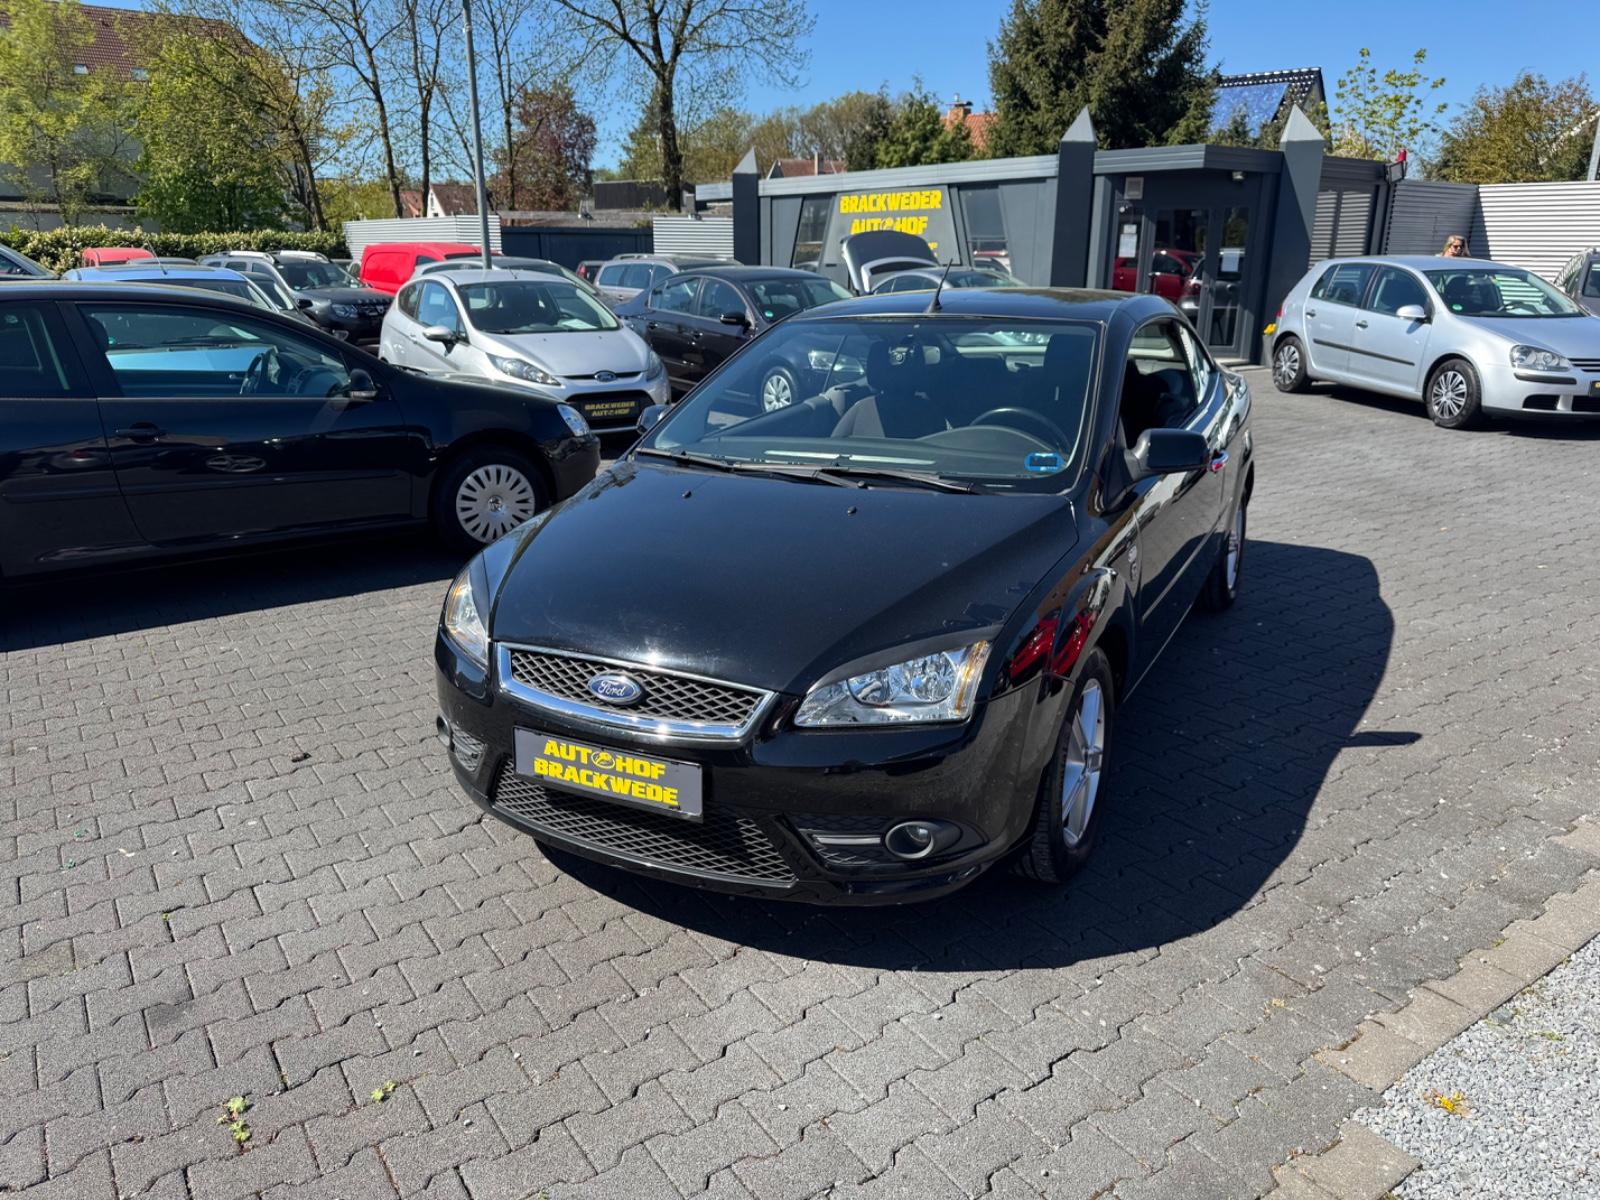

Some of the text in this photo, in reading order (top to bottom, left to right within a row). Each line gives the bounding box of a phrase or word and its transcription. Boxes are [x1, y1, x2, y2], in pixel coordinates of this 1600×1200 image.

[839, 190, 942, 214] BRACKWEDER
[598, 680, 626, 697] Ford
[533, 757, 679, 806] BRACKWEDE
